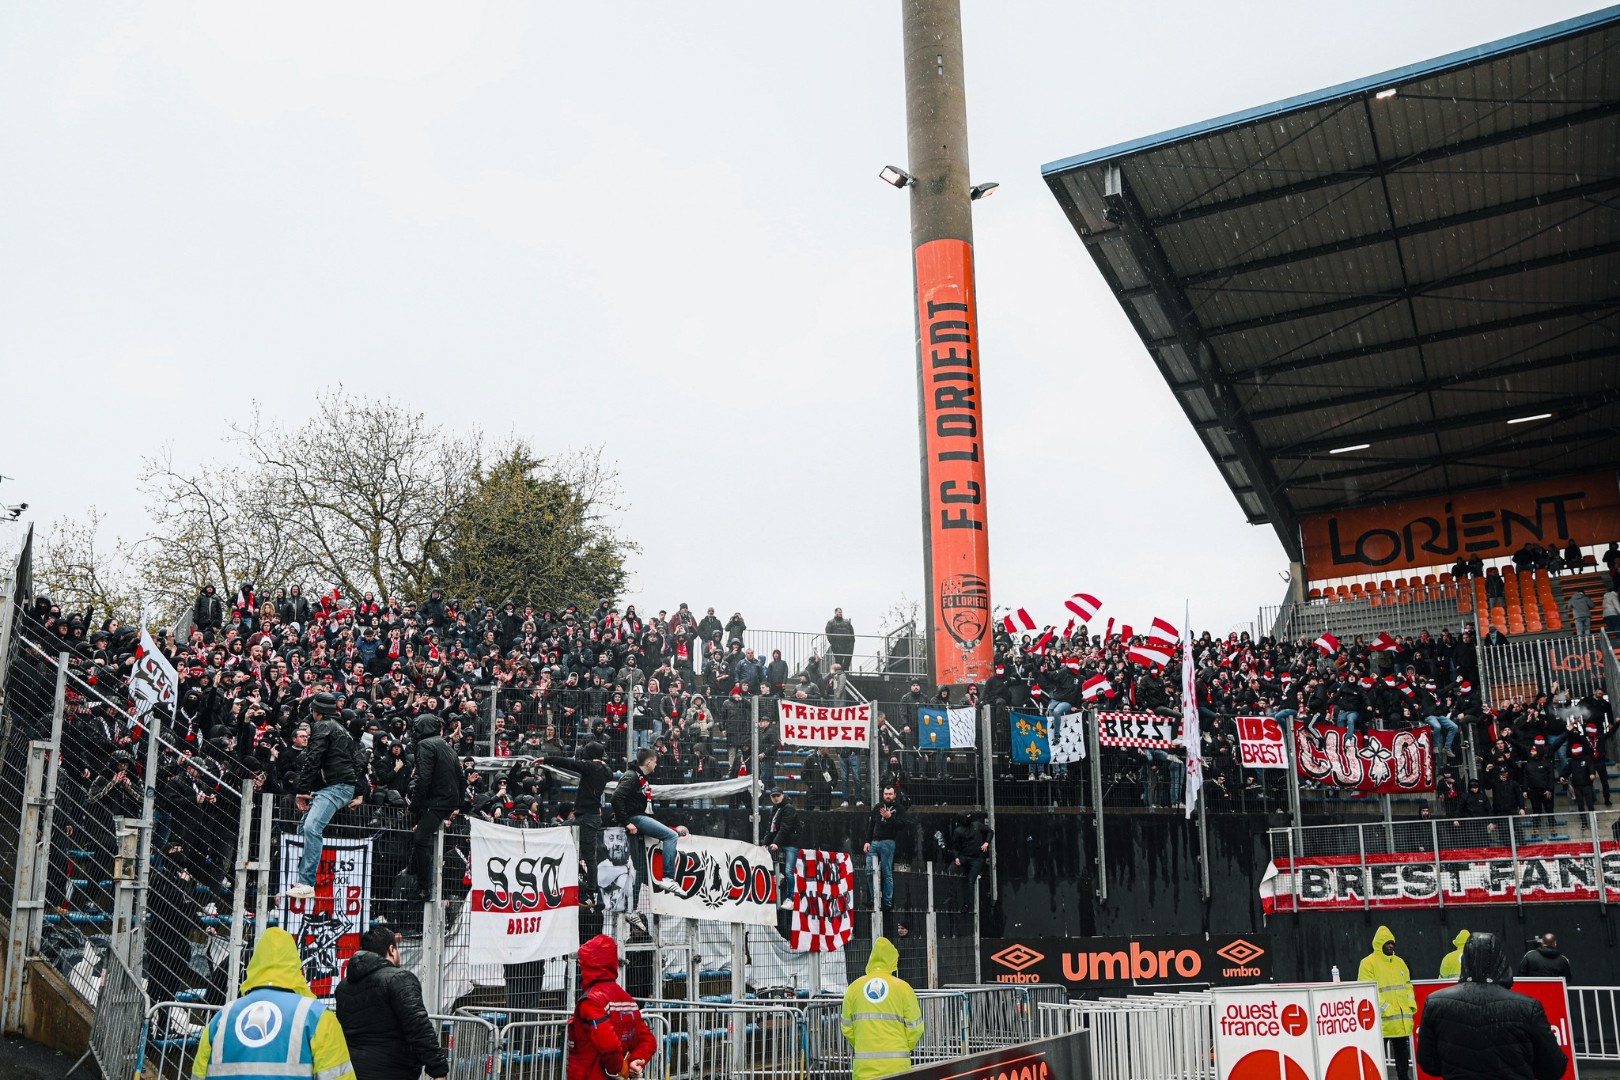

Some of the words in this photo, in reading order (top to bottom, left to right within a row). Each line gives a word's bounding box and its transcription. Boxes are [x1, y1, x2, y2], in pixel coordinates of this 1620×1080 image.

[927, 300, 979, 463] LORIENT
[940, 479, 983, 531] FC
[942, 597, 953, 607] FC
[956, 596, 988, 608] LORIENT
[784, 724, 866, 742] KEMPER
[1105, 719, 1174, 740] BRES
[1240, 743, 1285, 765] BREST
[729, 855, 771, 906] 90
[1300, 861, 1470, 900] BREST
[506, 917, 542, 935] BREST
[1062, 942, 1202, 981] umbro
[1222, 966, 1261, 978] umbro
[997, 972, 1041, 983] umbro
[1226, 1001, 1279, 1020] ouest
[1320, 996, 1356, 1018] ouest
[1220, 1016, 1280, 1037] france
[1316, 1015, 1357, 1037] france
